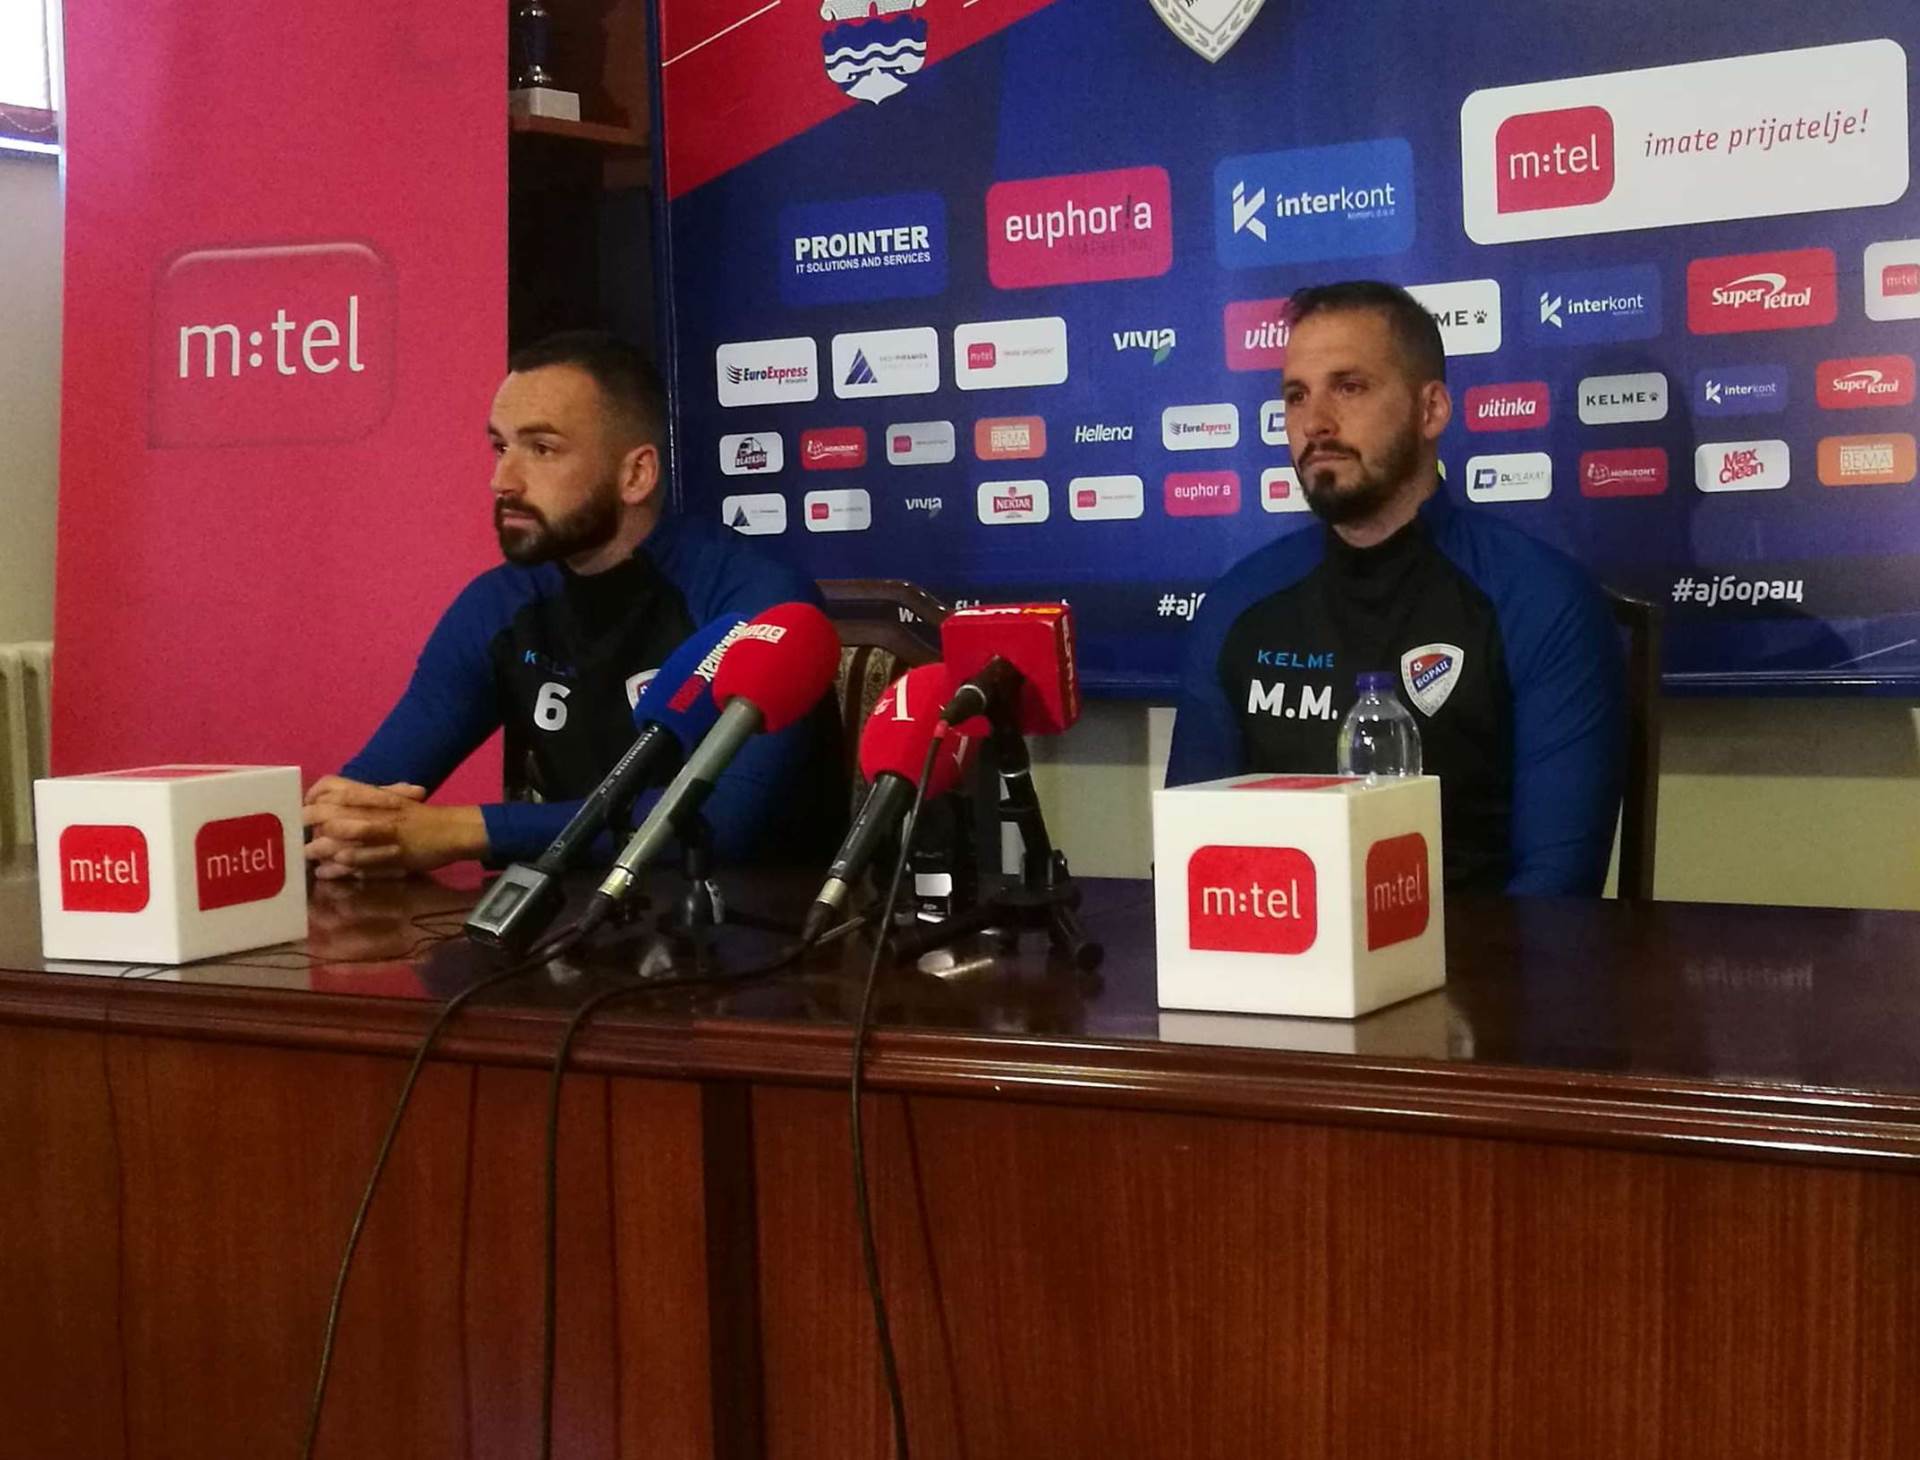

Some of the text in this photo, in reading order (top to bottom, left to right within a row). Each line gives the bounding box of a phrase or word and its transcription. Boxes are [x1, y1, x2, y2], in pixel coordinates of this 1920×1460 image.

[1509, 108, 1869, 180] m:tel imate prijatelje!
[1277, 182, 1395, 218] interkont
[795, 225, 930, 261] PROINTER
[796, 251, 931, 275] IT SOLUTIONS AND SERVICES
[1568, 294, 1644, 315] interkont
[1712, 286, 1764, 308] Super
[179, 295, 365, 378] m:tel
[744, 366, 808, 384] EuroExpress
[1833, 378, 1867, 392] Super
[1586, 392, 1646, 406] KELME
[1725, 382, 1776, 396] interkont
[1478, 397, 1536, 418] vitinka
[1075, 424, 1133, 442] Hellena
[1182, 422, 1231, 435] EuroExpress
[1724, 449, 1758, 469] Max
[1719, 462, 1763, 484] Clean
[1257, 650, 1334, 668] KELME
[534, 682, 571, 731] 6
[1248, 679, 1338, 720] M.M.
[69, 851, 139, 884] m:tel
[207, 839, 275, 880] m:tel
[1373, 863, 1422, 911] m:tel
[1203, 879, 1301, 920] m:tel
